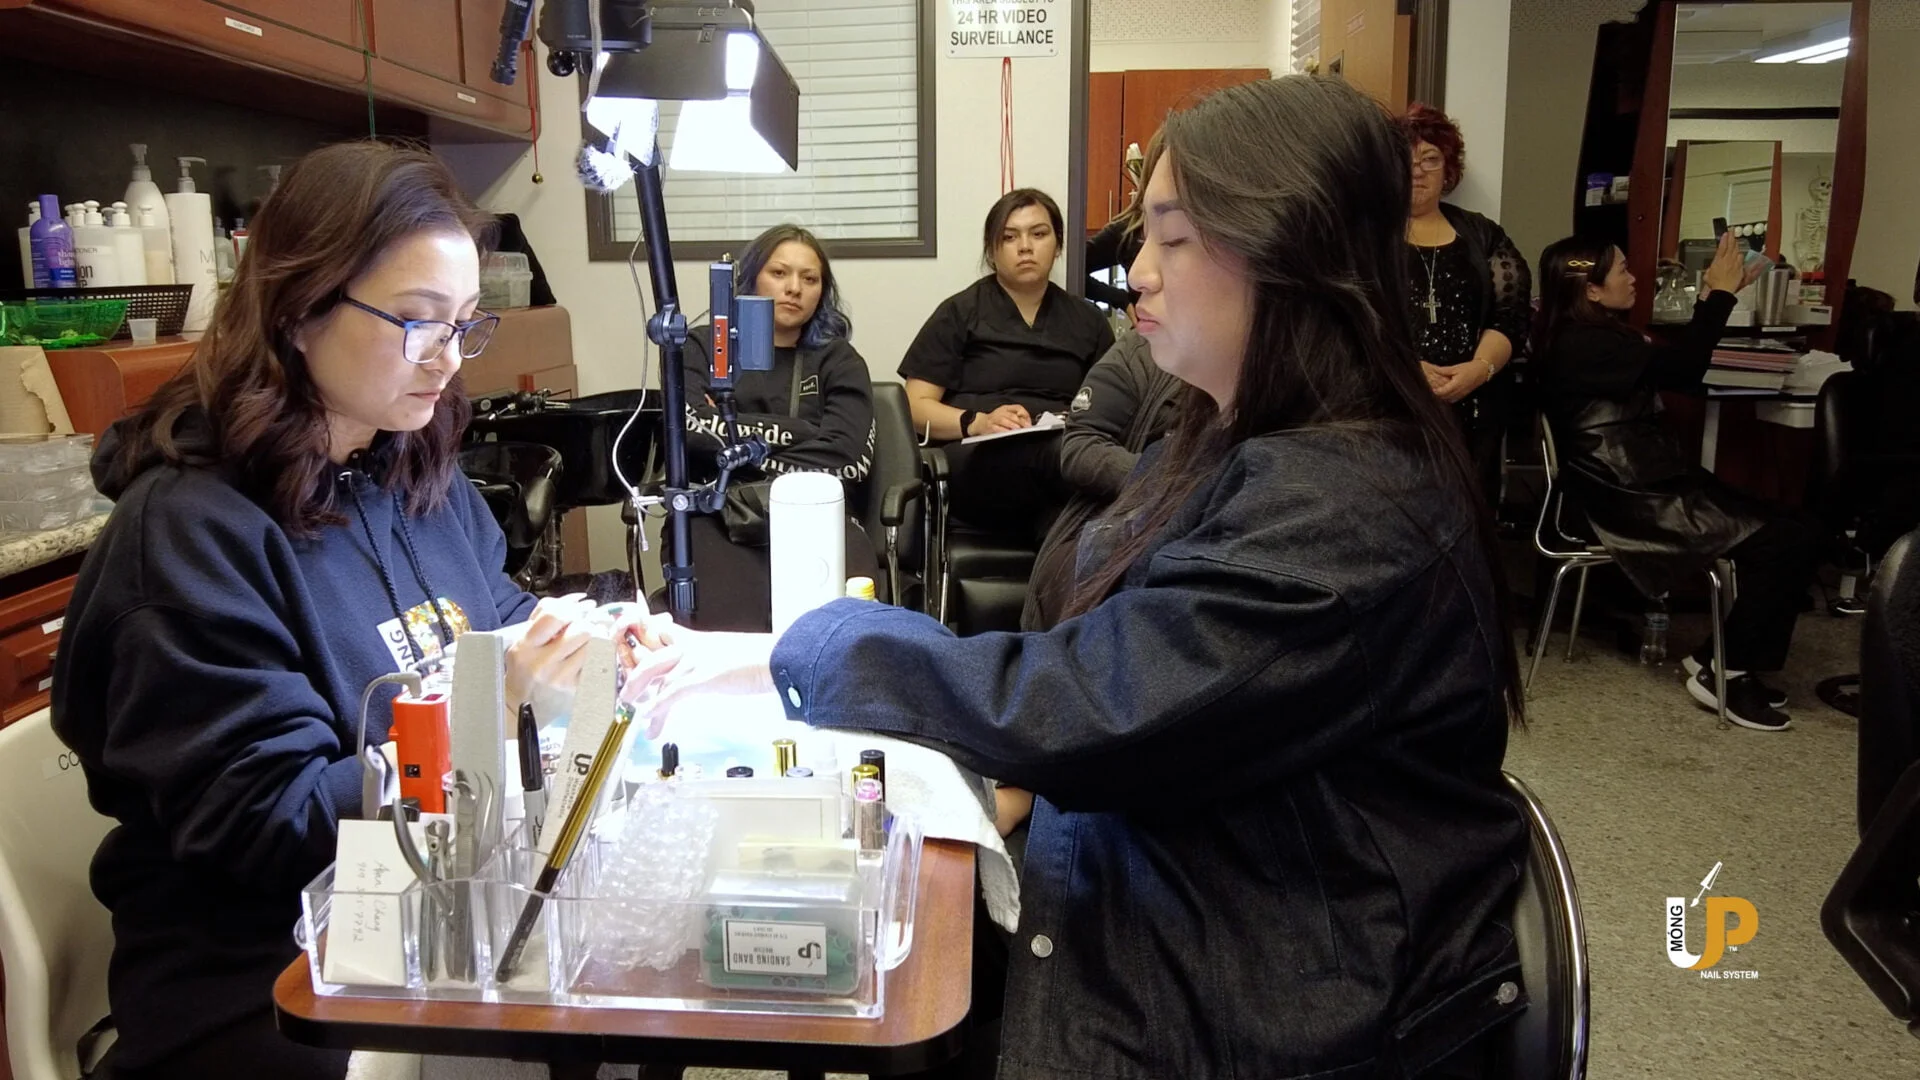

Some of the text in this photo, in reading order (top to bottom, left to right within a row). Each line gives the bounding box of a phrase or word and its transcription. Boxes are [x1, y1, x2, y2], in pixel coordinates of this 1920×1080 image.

[957, 8, 1047, 25] 24 HR VIDEO
[950, 29, 1053, 46] SURVEILLANCE
[733, 952, 791, 967] SANDING BAND
